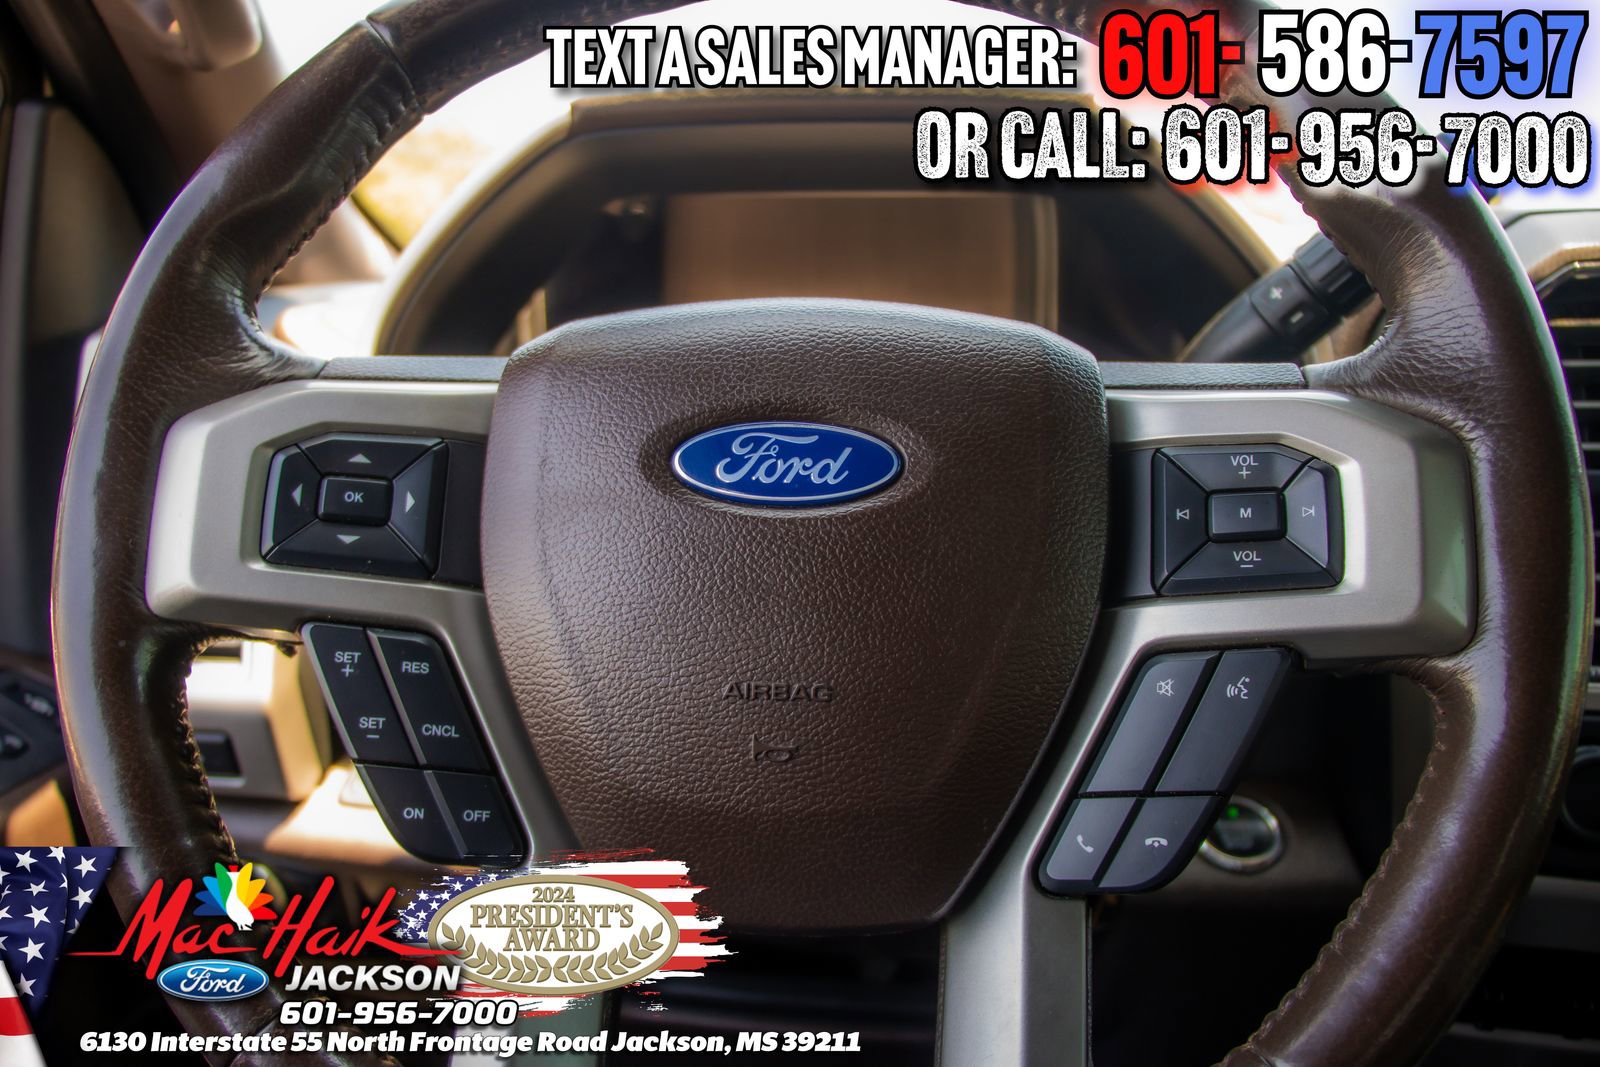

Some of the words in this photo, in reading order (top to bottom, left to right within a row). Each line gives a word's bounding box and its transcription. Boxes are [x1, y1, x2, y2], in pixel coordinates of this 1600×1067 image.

[715, 432, 853, 484] Ford
[1230, 455, 1259, 466] VOL
[344, 491, 364, 503] OK
[1239, 507, 1252, 519] M
[1233, 551, 1262, 562] VOL
[334, 651, 362, 664] SET
[401, 661, 430, 675] RES
[721, 681, 833, 702] AIRBAG
[358, 716, 386, 730] SET
[421, 724, 460, 738] CNCL
[403, 807, 425, 820] ON
[463, 809, 491, 823] OFF
